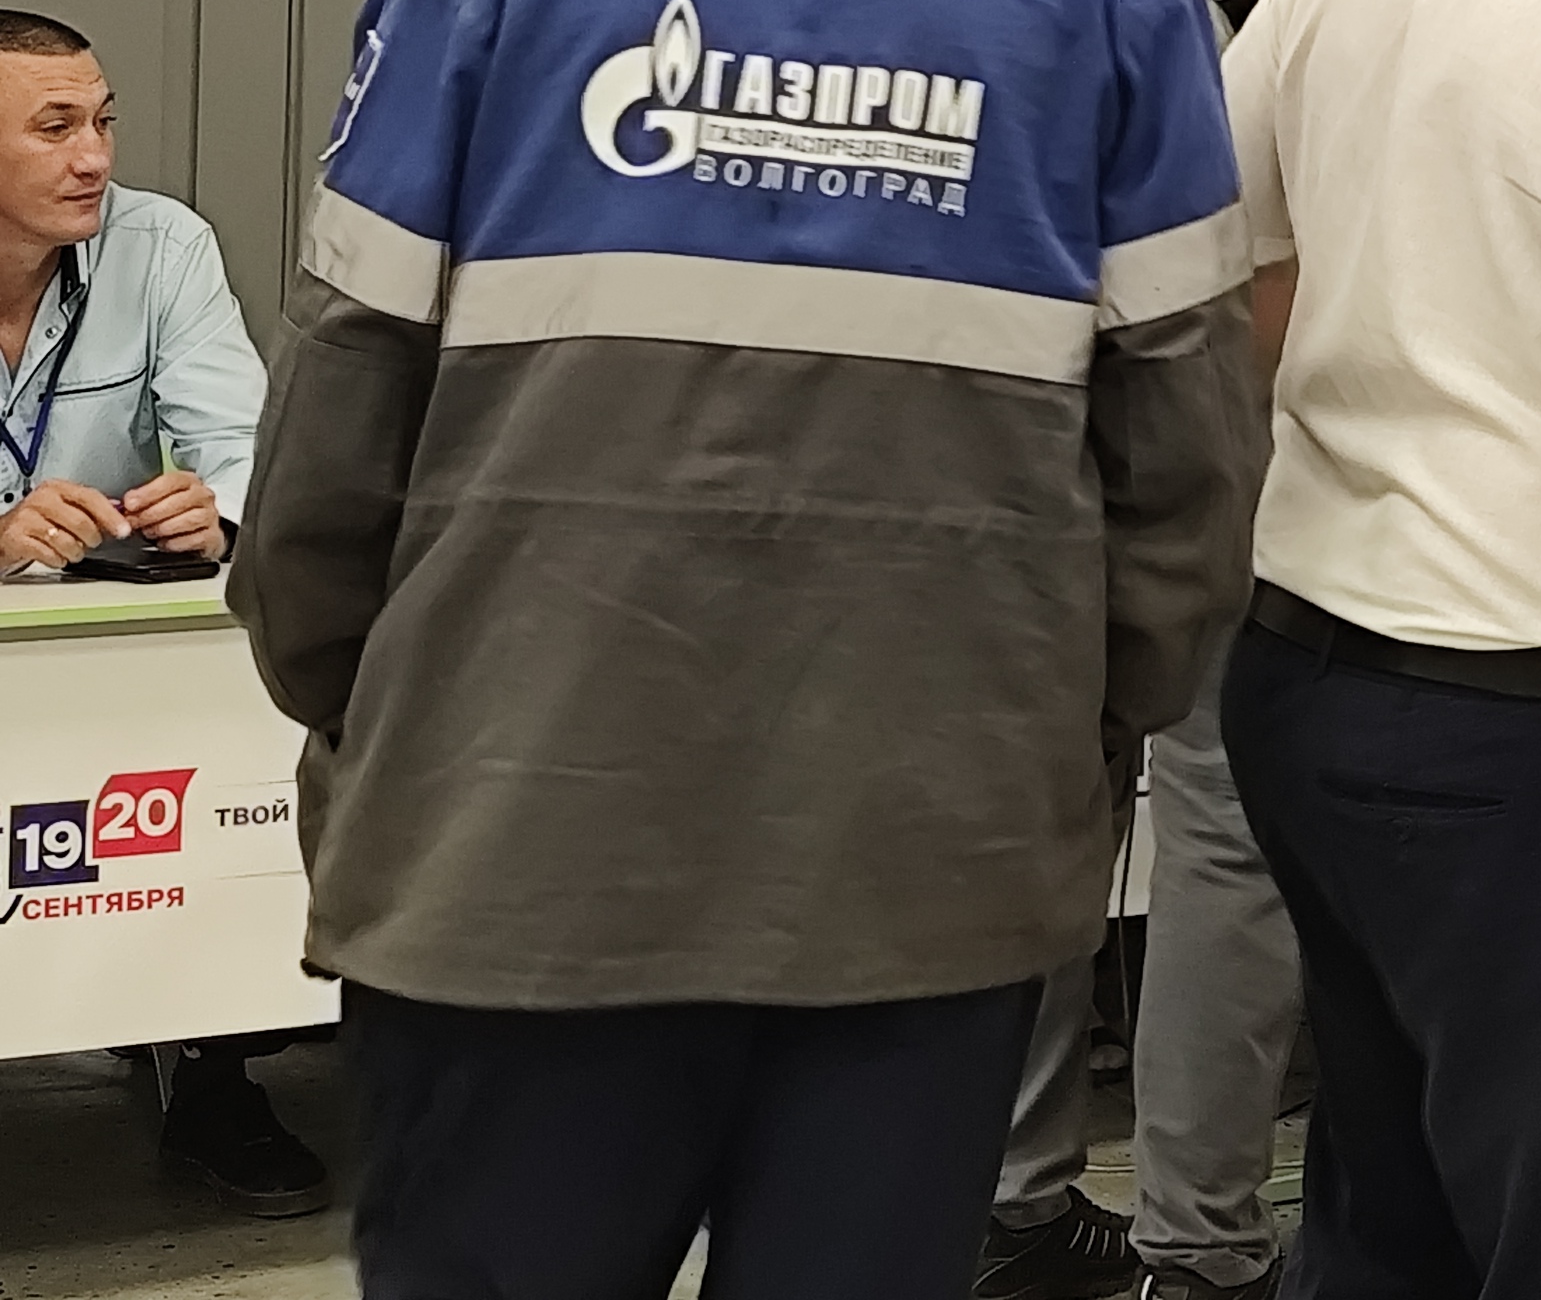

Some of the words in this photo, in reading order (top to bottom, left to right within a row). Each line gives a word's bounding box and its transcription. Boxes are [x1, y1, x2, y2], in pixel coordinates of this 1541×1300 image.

[700, 48, 986, 142] ГАЗПРОМ
[705, 121, 969, 172] ГАЗОРАСПРЕДЕЛЕНИЕ
[693, 154, 969, 218] ВОЛГОГРАД
[98, 787, 179, 842] 20
[215, 798, 290, 827] ТВОЙ
[16, 820, 83, 872] 19
[22, 886, 185, 920] СЕНТЯБРЯ
